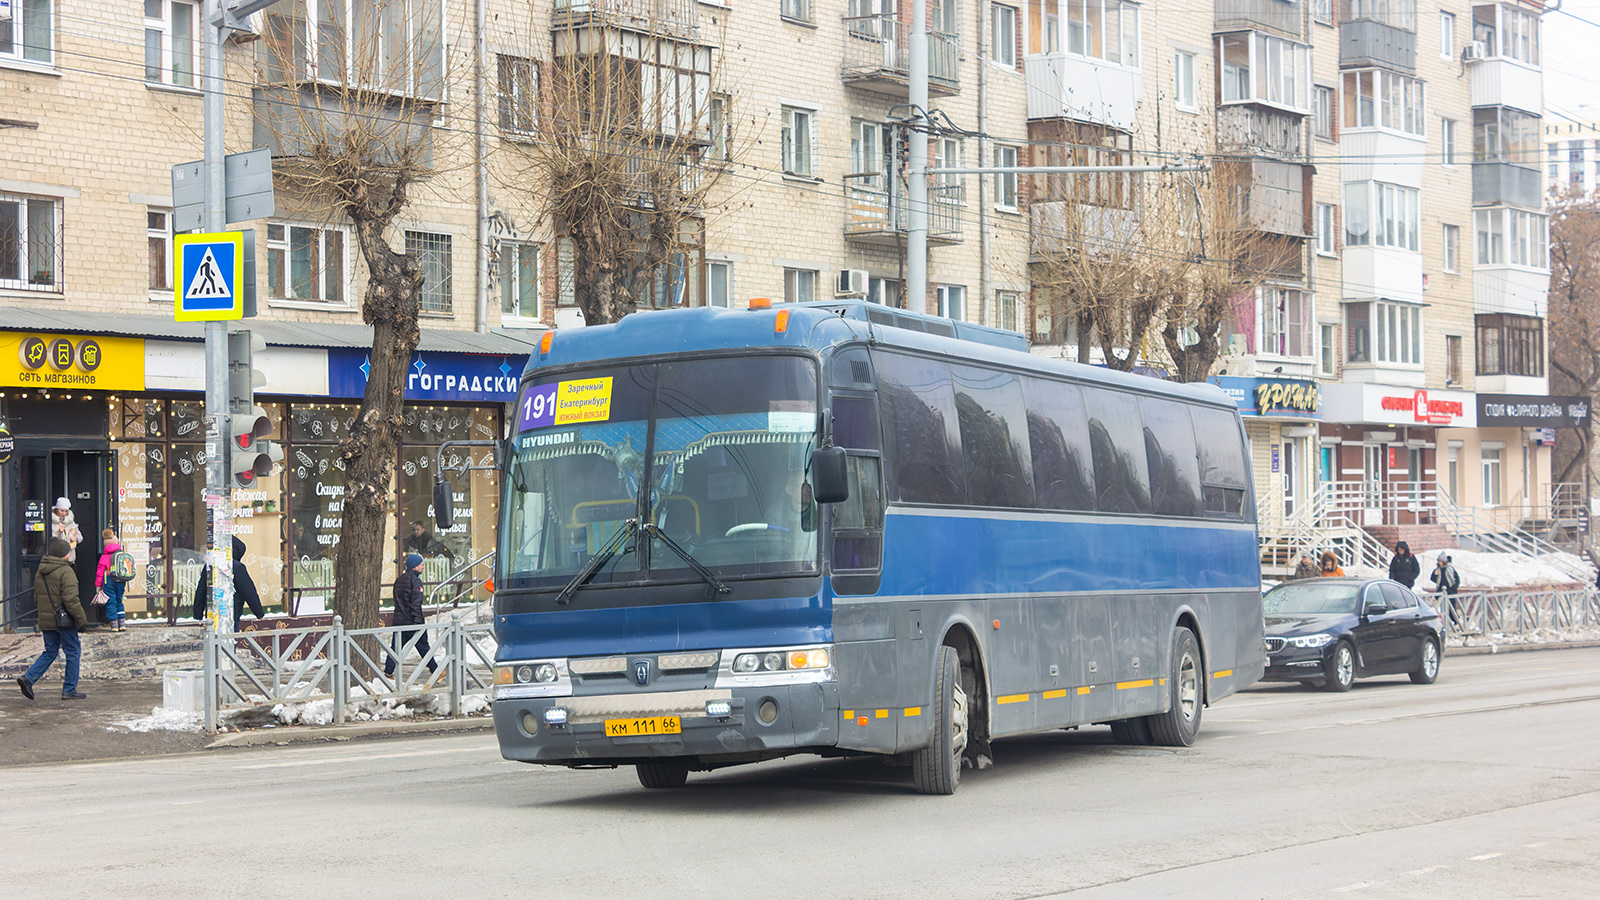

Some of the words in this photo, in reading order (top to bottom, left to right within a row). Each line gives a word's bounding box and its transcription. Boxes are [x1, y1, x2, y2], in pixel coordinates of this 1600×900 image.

[19, 372, 41, 382] сеть
[45, 373, 96, 384] магазинов
[405, 373, 521, 393] ГОГРАДСКИ
[567, 380, 604, 394] Заречный
[523, 391, 557, 421] 191
[560, 397, 608, 408] Екатеринбург
[559, 412, 583, 421] ЮЖНЫЙ
[583, 410, 607, 419] ВОКЗАЛ
[522, 432, 575, 448] HYUNDAI
[232, 508, 254, 518] ечка
[452, 507, 474, 521] ремя
[143, 523, 163, 533] 21:00
[322, 517, 343, 528] посл
[232, 525, 254, 534] роги
[316, 533, 331, 545] час
[612, 723, 628, 734] КМ
[633, 720, 656, 733] 111
[662, 718, 676, 728] 66
